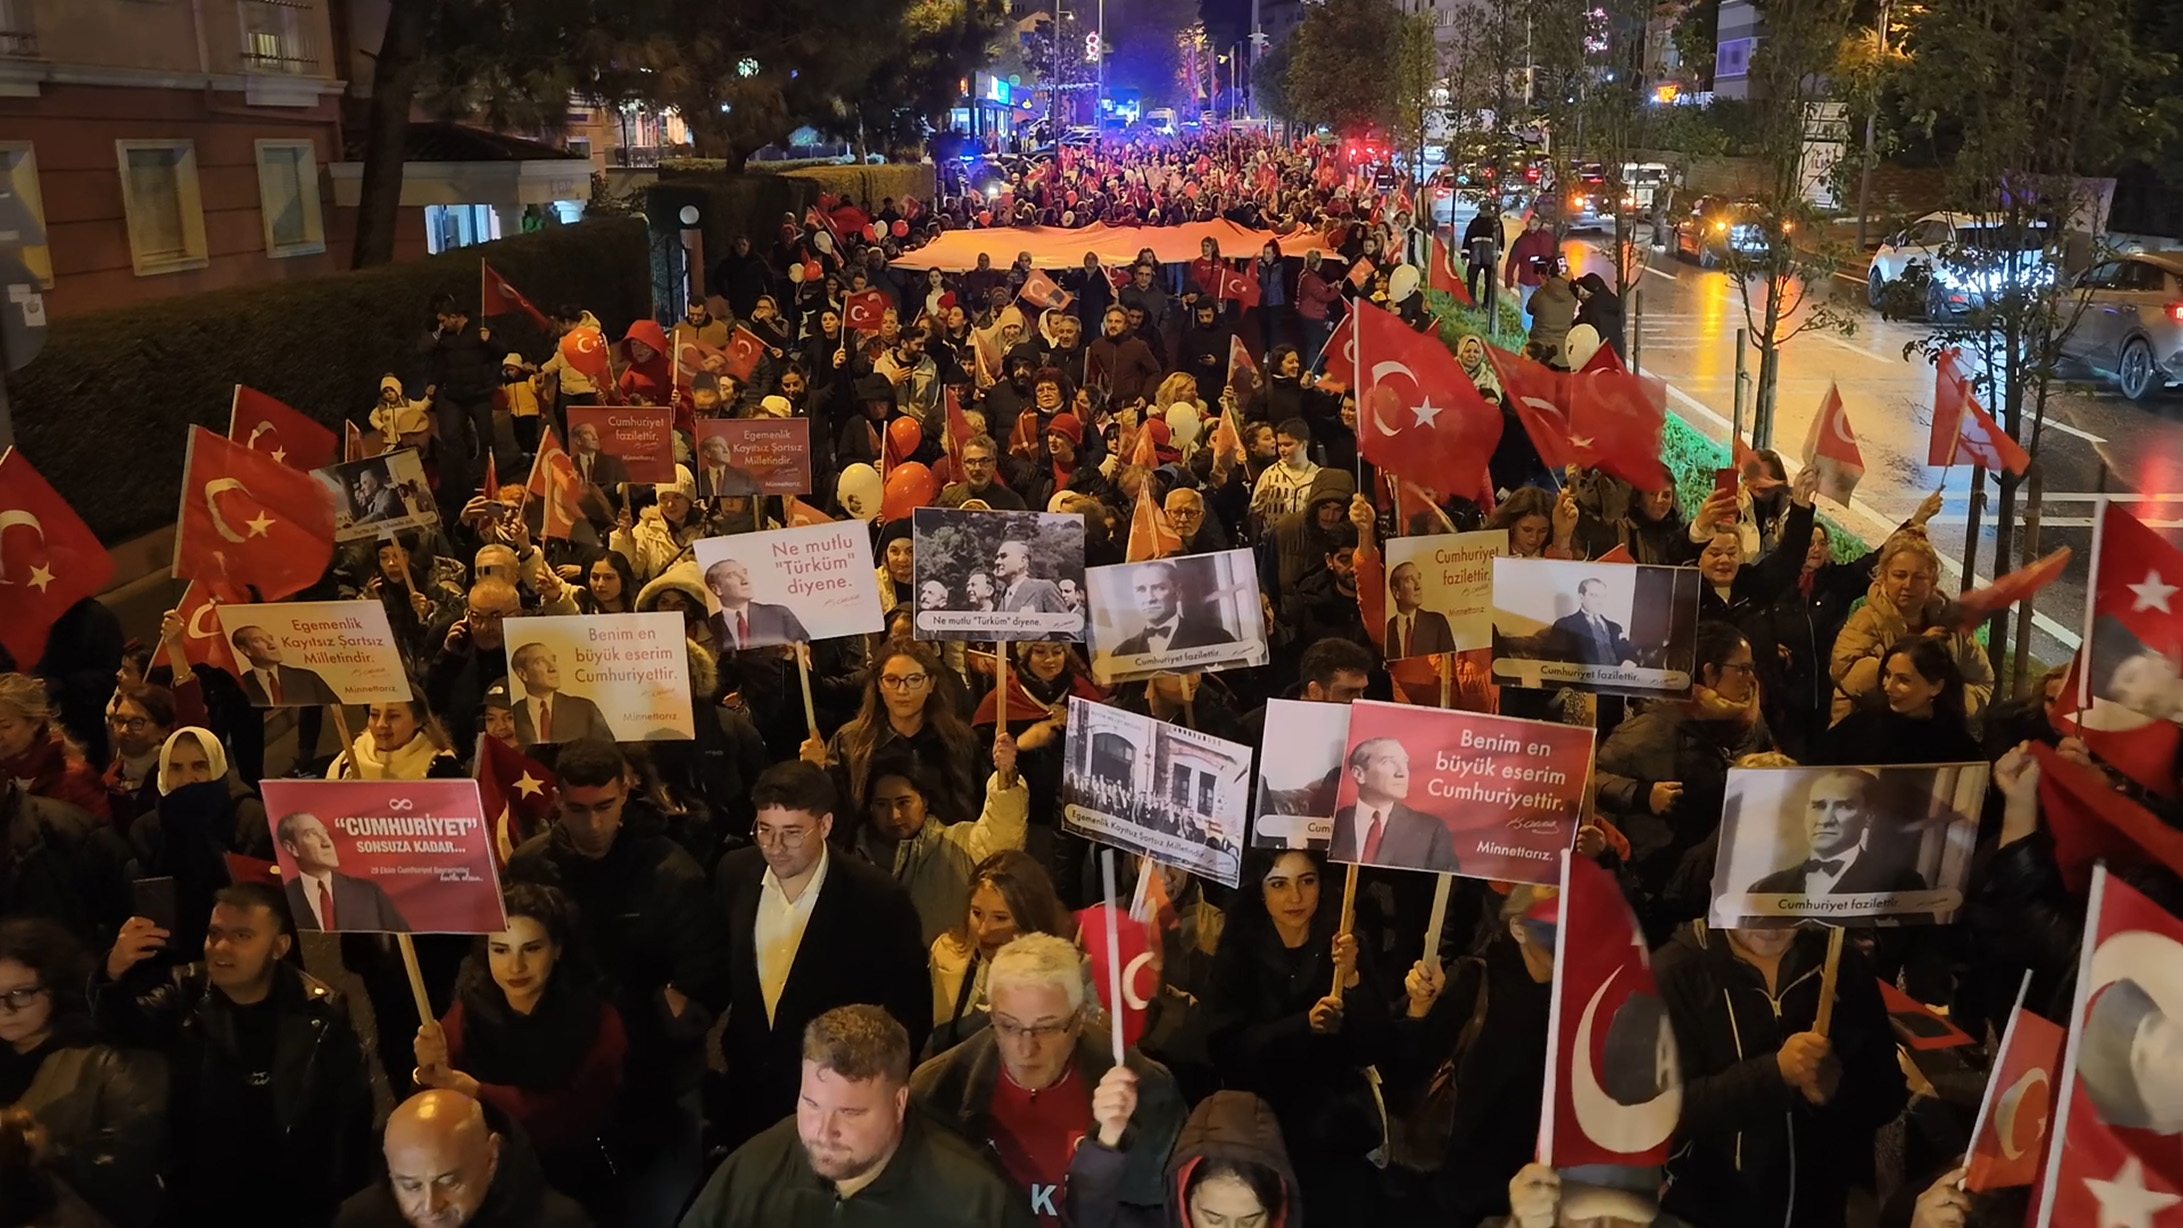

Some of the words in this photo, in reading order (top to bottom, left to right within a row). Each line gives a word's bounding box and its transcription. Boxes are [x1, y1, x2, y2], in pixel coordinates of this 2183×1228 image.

[608, 416, 664, 429] Cumhuriyet
[616, 429, 659, 442] fazilettir.
[744, 430, 792, 445] Egemenlik
[733, 444, 769, 458] Kayıtsız
[772, 443, 803, 456] Şartsız
[744, 455, 792, 465] Milletindir.
[772, 541, 799, 557] Ne
[806, 534, 853, 551] mutlu
[1435, 545, 1499, 565] Cumhuriyet
[776, 552, 855, 576] "Türküm"
[1443, 567, 1490, 586] fazilettir.
[788, 577, 852, 596] diyene.
[292, 617, 363, 633] Egemenlik
[933, 616, 946, 625] Ne
[948, 616, 972, 626] mutlu
[973, 616, 1011, 626] "Türküm"
[1012, 617, 1042, 628] diyene.
[281, 636, 335, 650] Kayıtsız
[339, 636, 384, 648] Şartsız
[588, 628, 634, 642] Benim
[638, 629, 656, 640] en
[304, 651, 375, 664] Milletindir.
[576, 648, 620, 666] büyük
[626, 646, 673, 660] eserim
[1135, 654, 1183, 667] Cumhuriyet
[1184, 649, 1222, 662] fazilettir.
[575, 667, 678, 684] Cumhuriyettir.
[1540, 665, 1595, 680] Cumhuriyet
[1598, 669, 1640, 682] fazilettir.
[1460, 729, 1520, 754] Benim
[1528, 740, 1552, 756] en
[1436, 752, 1494, 780] büyük
[1502, 764, 1566, 784] eserim
[1428, 779, 1564, 812] Cumhuriyettir.
[1072, 809, 1110, 828] Egemenlik
[1308, 822, 1333, 833] Cum
[356, 841, 412, 854] SONSUZA
[414, 840, 466, 854] KADAR...
[1476, 841, 1553, 861] Minnettarız.
[1778, 899, 1848, 912] Cumhuriyet
[1032, 1184, 1058, 1216] K
